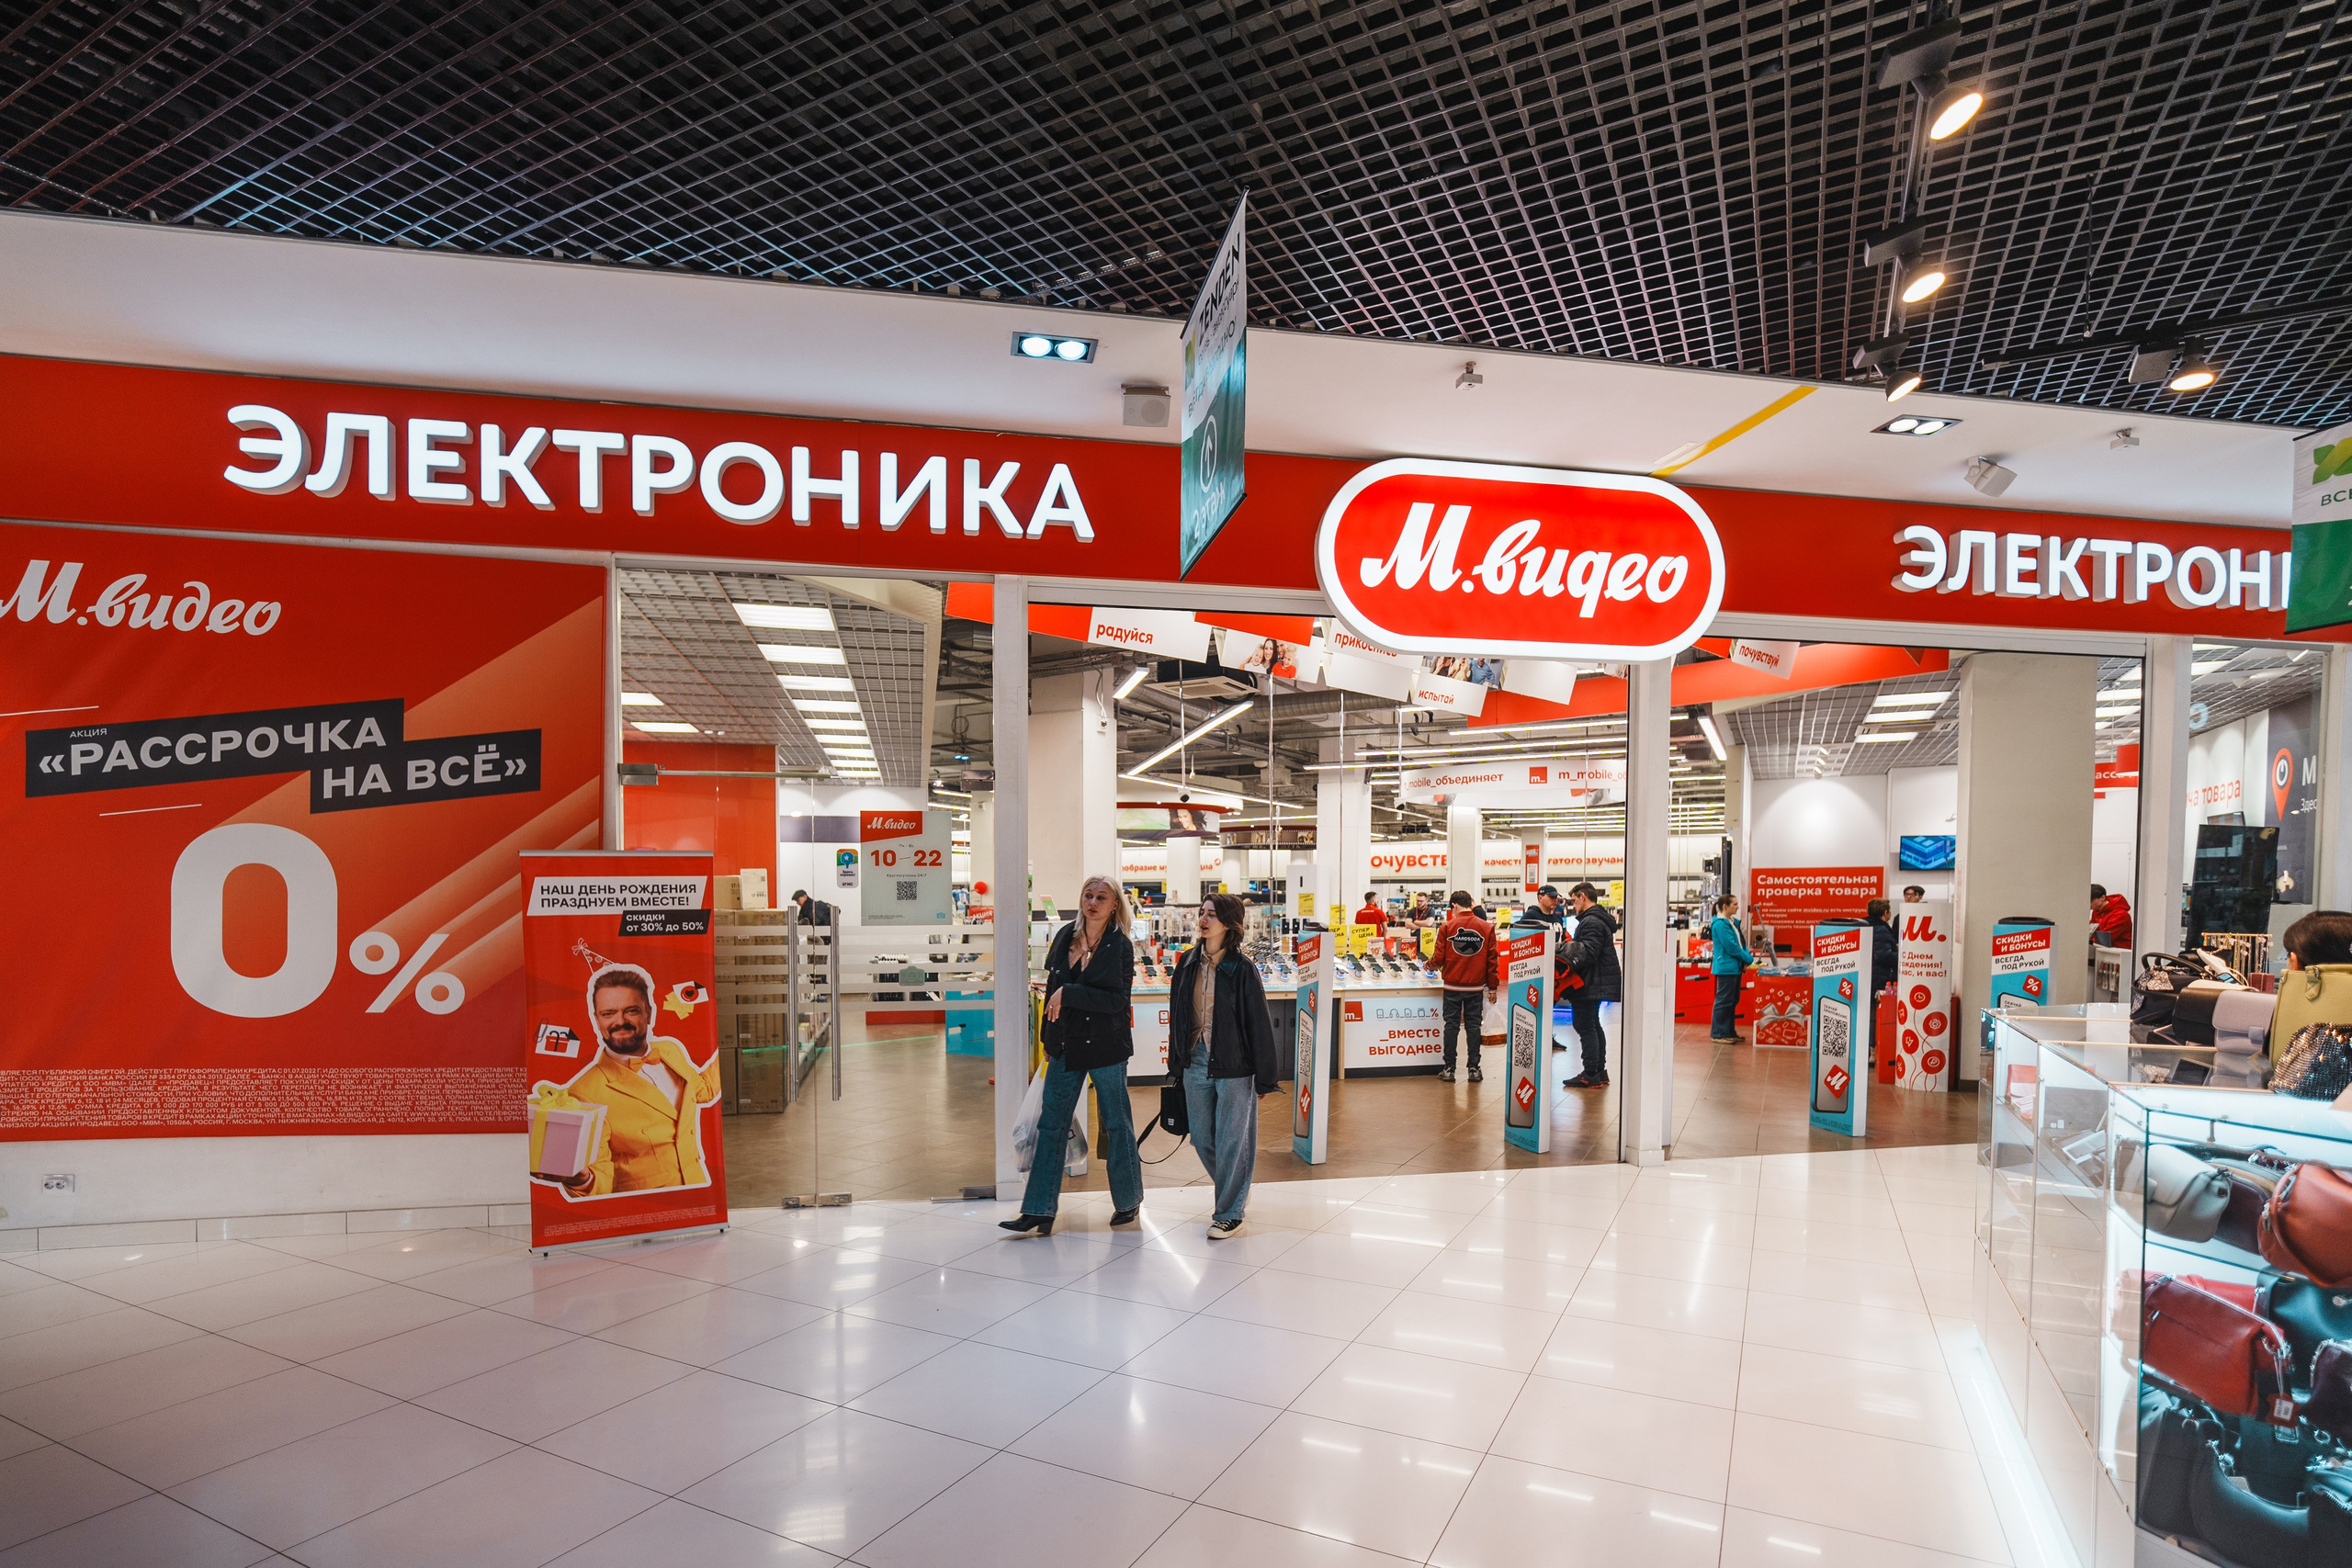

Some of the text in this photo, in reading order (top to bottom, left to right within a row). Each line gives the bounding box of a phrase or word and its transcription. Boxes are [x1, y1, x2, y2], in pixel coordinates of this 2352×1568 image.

[1199, 231, 1240, 347] ZENDEN
[223, 404, 1096, 543] ЭЛЕКТРОНИКА
[1193, 509, 1200, 539] 2
[1360, 502, 1689, 618] М.видео
[1892, 525, 2292, 610] ЭЛЕКТРОН
[0, 558, 282, 636] М.видео
[1096, 624, 1153, 645] радуйся
[1739, 645, 1781, 669] почувствуй
[1419, 690, 1454, 705] испытай
[69, 728, 107, 739] АКЦИЯ
[39, 716, 387, 775] «РАССРОЧКА
[322, 744, 527, 799] НА ВСЁ»
[2201, 780, 2241, 808] товара
[866, 817, 916, 829] М.видео
[870, 850, 943, 866] 10 22
[1757, 874, 1878, 885] Самостоятельная
[540, 884, 696, 896] НАШ ДЕНЬ РОЖДЕНИЯ
[1758, 886, 1877, 898] проверка товара
[541, 897, 689, 908] ПРАЗДНУЕМ ВМЕСТЕ!
[626, 914, 665, 922] скидки
[627, 921, 704, 932] от 30% до 50%
[1510, 938, 1532, 951] СКИДКИ
[1816, 934, 1846, 946] СКИДКИ
[1996, 933, 2032, 945] СКИДКИ
[1519, 945, 1542, 957] БОНУСЫ
[1821, 941, 1857, 954] И БОНУСЫ
[2009, 940, 2046, 952] БОНУСЫ
[1816, 957, 1839, 966] ВСЕГДА
[1907, 952, 1933, 960] Днем
[1995, 955, 2024, 964] ВСЕГДА
[1510, 962, 1528, 971] ВСЕГДА
[1835, 961, 1856, 971] РУКОЙ
[2018, 958, 2044, 968] РУКОЙ
[1524, 966, 1541, 976] РУКОЙ
[1369, 1043, 1442, 1056] выгоднее
